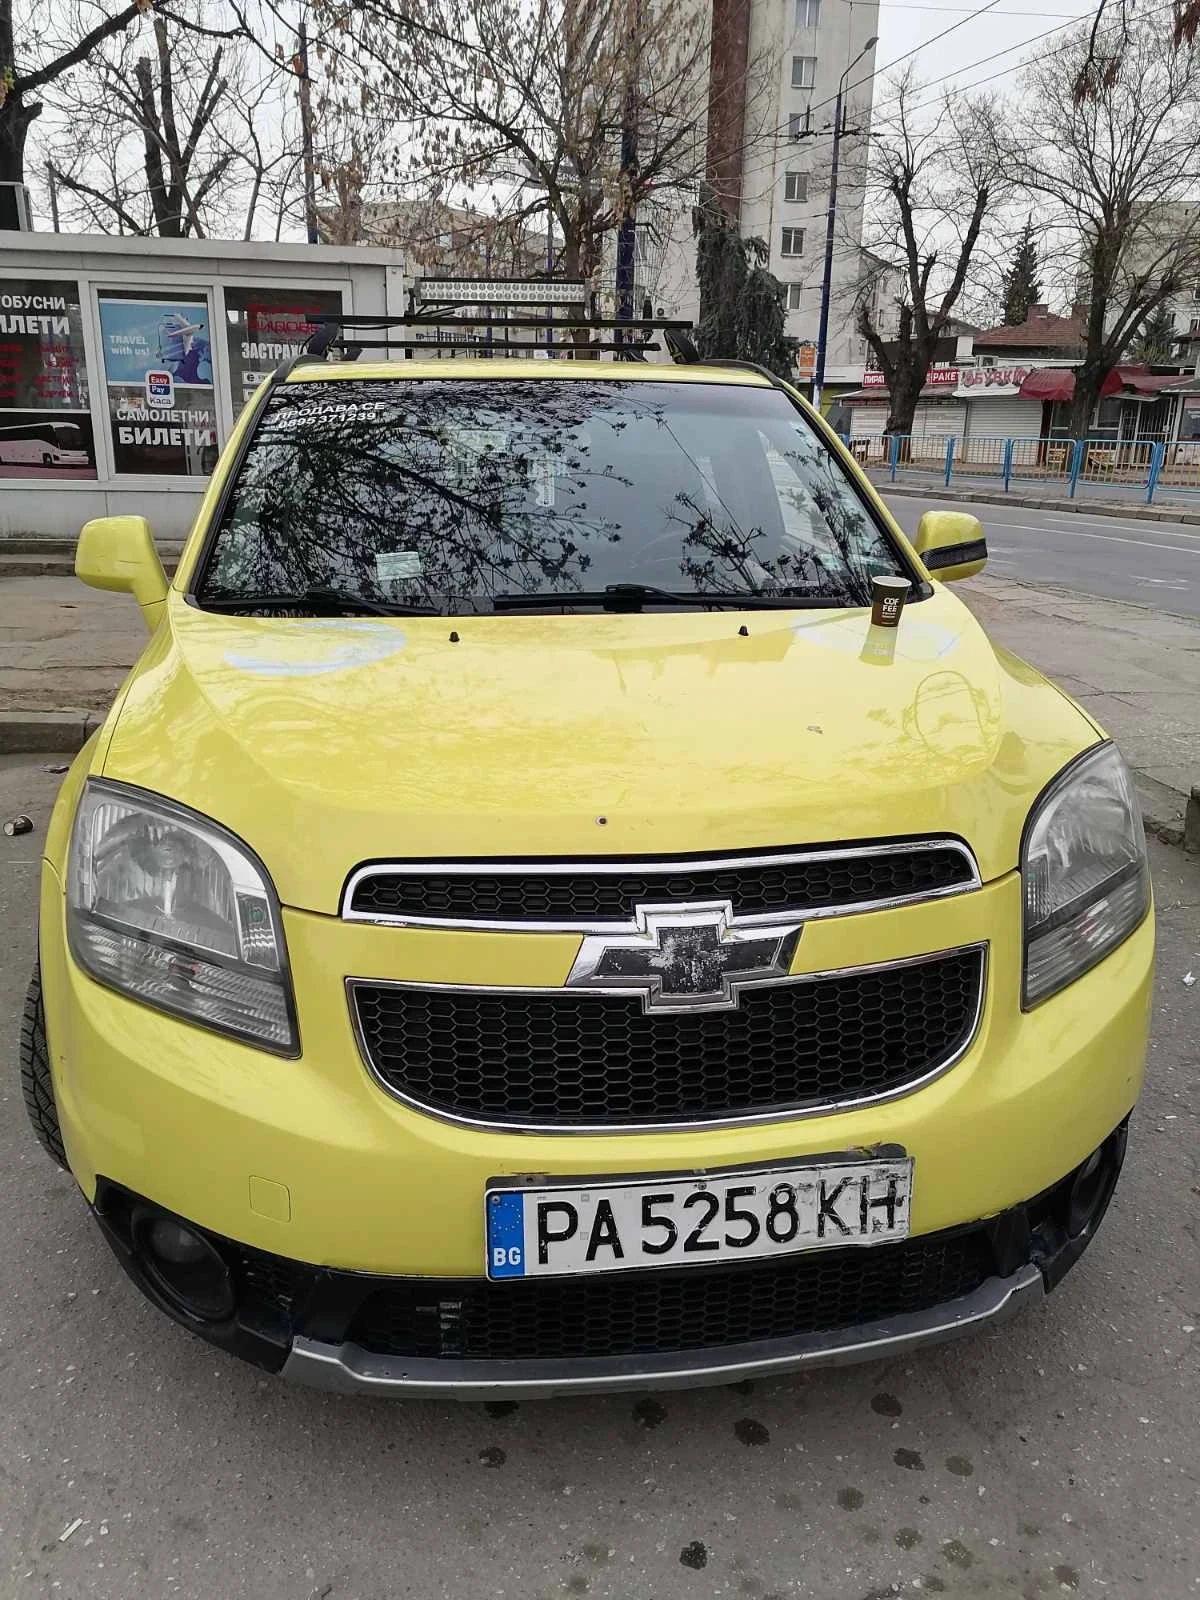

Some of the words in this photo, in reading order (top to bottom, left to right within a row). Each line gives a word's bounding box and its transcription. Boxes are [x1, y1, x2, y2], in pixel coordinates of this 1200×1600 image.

[0, 294, 65, 310] ОБУСНИ
[110, 335, 149, 345] TRAVEL
[112, 346, 133, 355] with
[134, 347, 150, 355] us!
[151, 375, 168, 384] Easy
[151, 386, 165, 394] Pay
[362, 402, 386, 410] СЕ
[116, 408, 209, 423] САМОЛЕТНИ
[118, 427, 210, 446] БИЛЕТИ
[641, 1182, 800, 1255] 5258
[493, 1246, 521, 1267] BG
